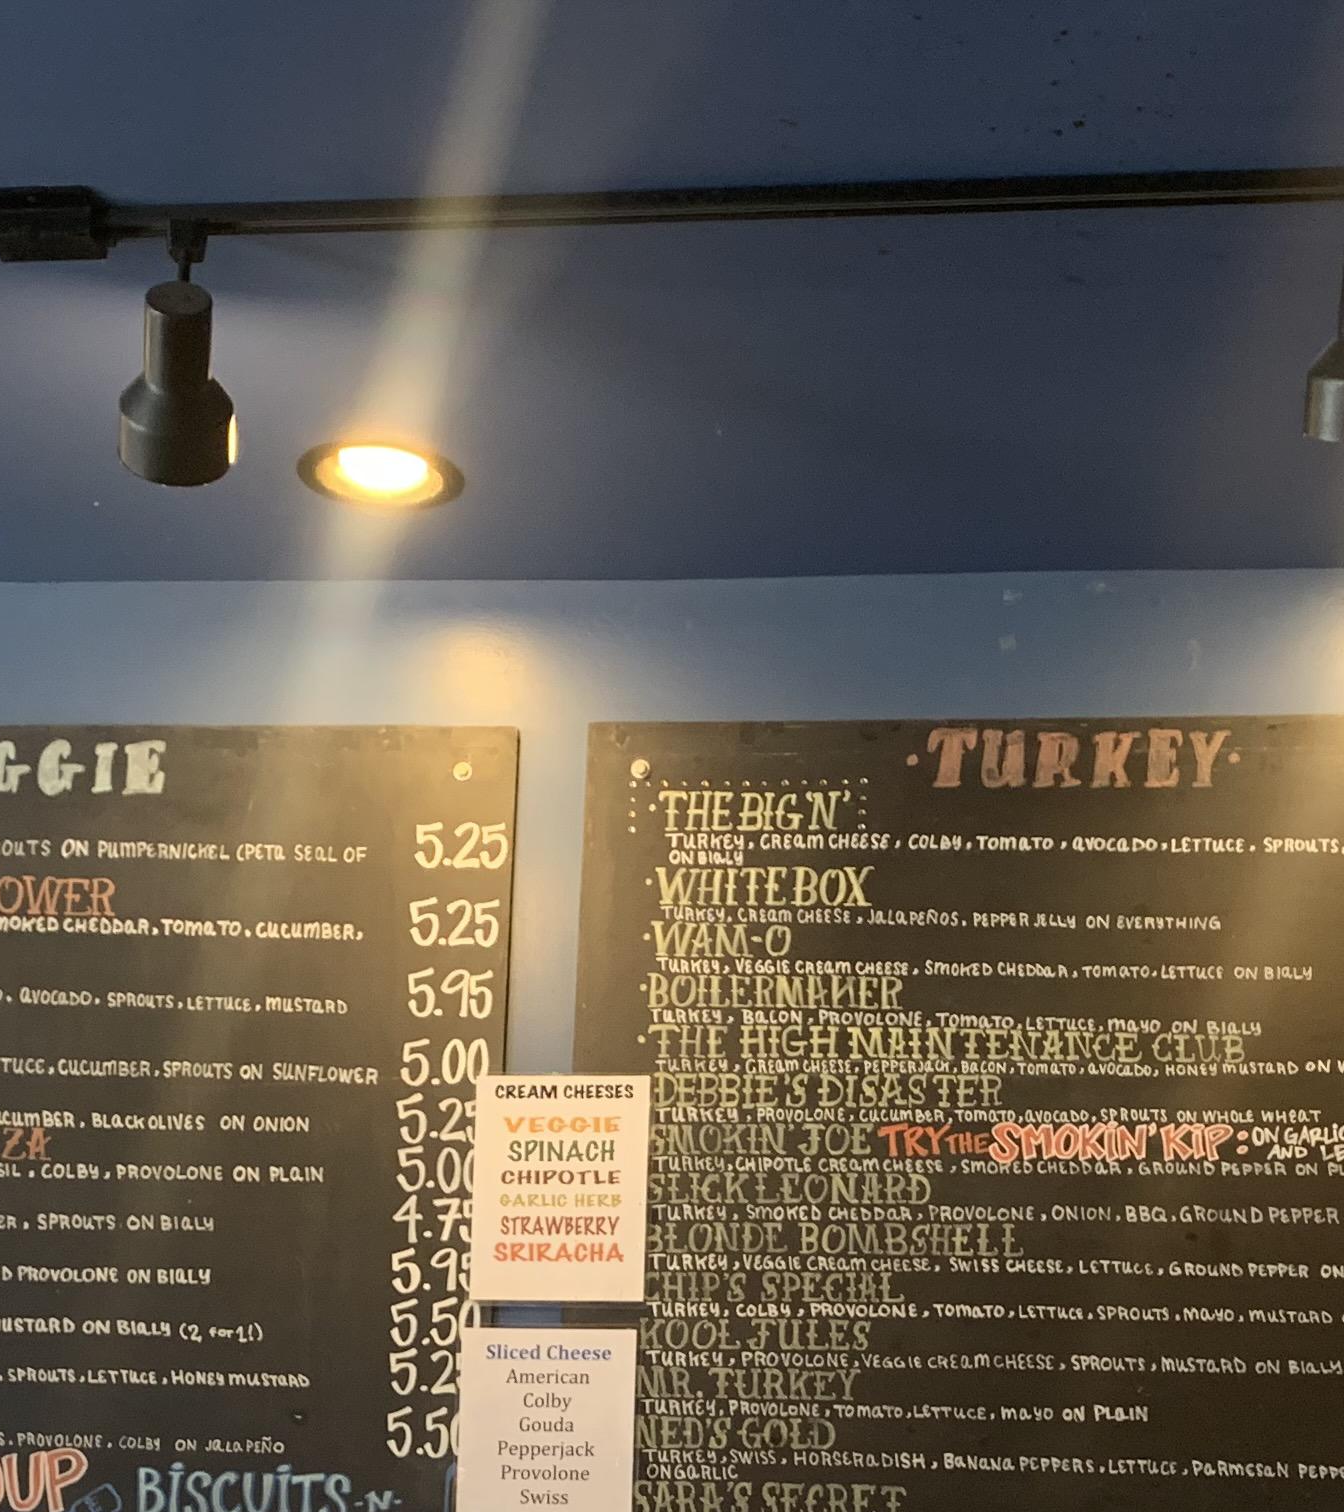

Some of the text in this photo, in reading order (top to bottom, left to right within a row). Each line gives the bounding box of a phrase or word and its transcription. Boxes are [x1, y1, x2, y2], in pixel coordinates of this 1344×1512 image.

[926, 727, 1233, 789] TURKEY
[414, 822, 508, 869] 5.25
[656, 866, 874, 907] WHITE BOX
[409, 898, 501, 947] 5.25
[1116, 915, 1221, 931] EVERYTHING
[652, 921, 792, 958] WAM-O
[408, 968, 494, 1019] 5.95
[240, 1062, 262, 1081] ON
[495, 1085, 634, 1099] CREAM CHEESES
[655, 1074, 1002, 1108] DEBBIE'S DISASTER
[220, 1115, 310, 1132] ON ONION
[503, 1116, 623, 1133] VEGGIE
[877, 1124, 953, 1158] TRY
[946, 1130, 990, 1154] THE
[1253, 1126, 1281, 1146] ON
[508, 1140, 615, 1162] SPINACH
[1267, 1145, 1307, 1160] AND
[501, 1170, 621, 1184] CHIPOTLE
[500, 1194, 622, 1207] GARLIC HERB
[500, 1216, 620, 1235] STRAWBERRY
[493, 1243, 624, 1262] SRIRACHA
[486, 1344, 612, 1360] Sliced Cheese
[506, 1369, 590, 1384] American
[523, 1393, 572, 1412] Colby
[519, 1417, 574, 1432] Gouda
[497, 1441, 594, 1460] Pepperjack
[501, 1465, 590, 1480] Provolone
[520, 1489, 569, 1504] Swiss
